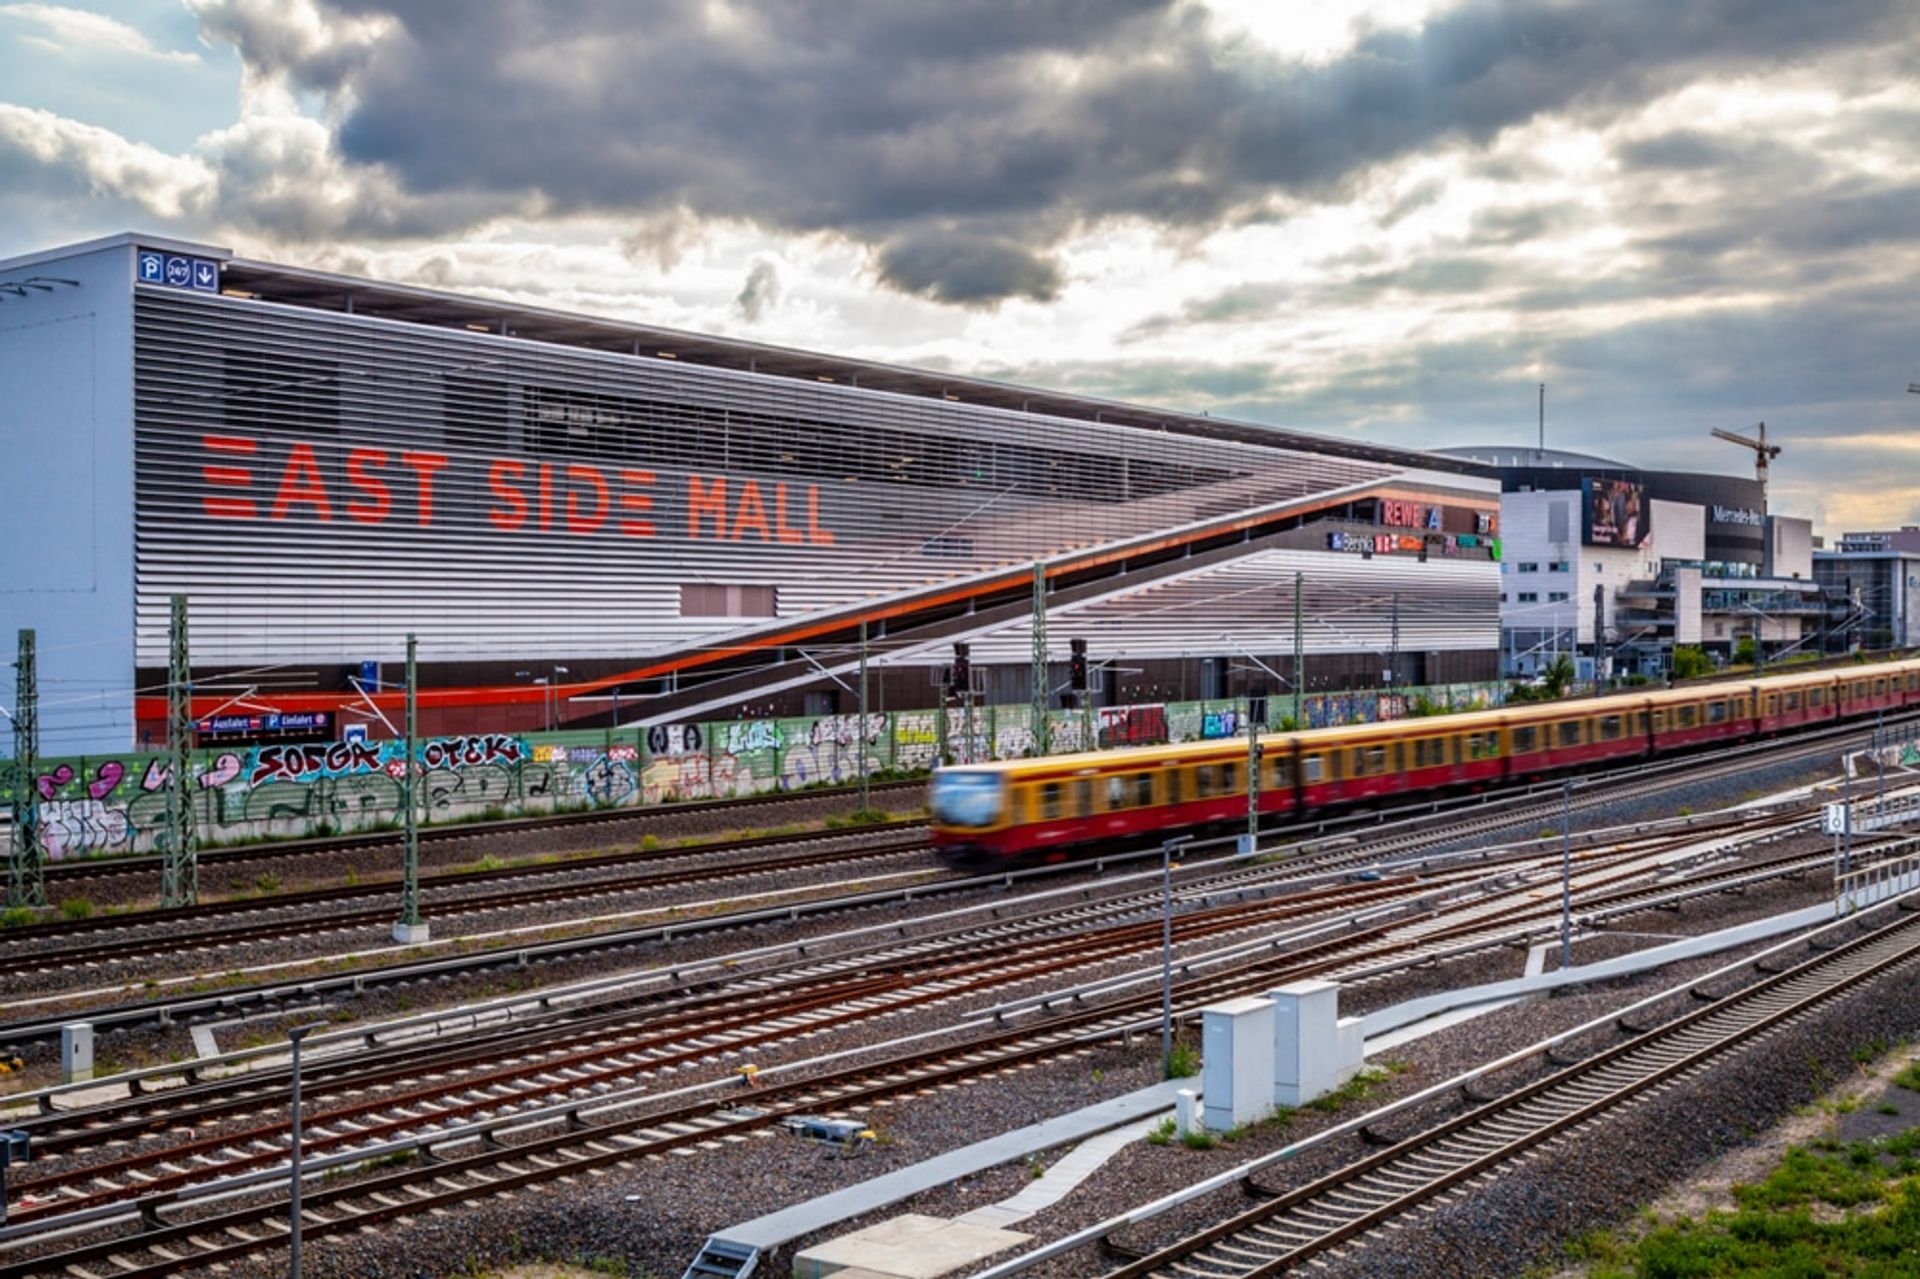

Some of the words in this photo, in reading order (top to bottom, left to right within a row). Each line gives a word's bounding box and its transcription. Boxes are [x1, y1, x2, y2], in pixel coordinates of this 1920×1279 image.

[203, 434, 448, 526] EAST
[488, 458, 656, 536] SIDE
[687, 474, 836, 545] MALL
[1384, 501, 1421, 528] REWE
[213, 716, 248, 729] Ausfahrt
